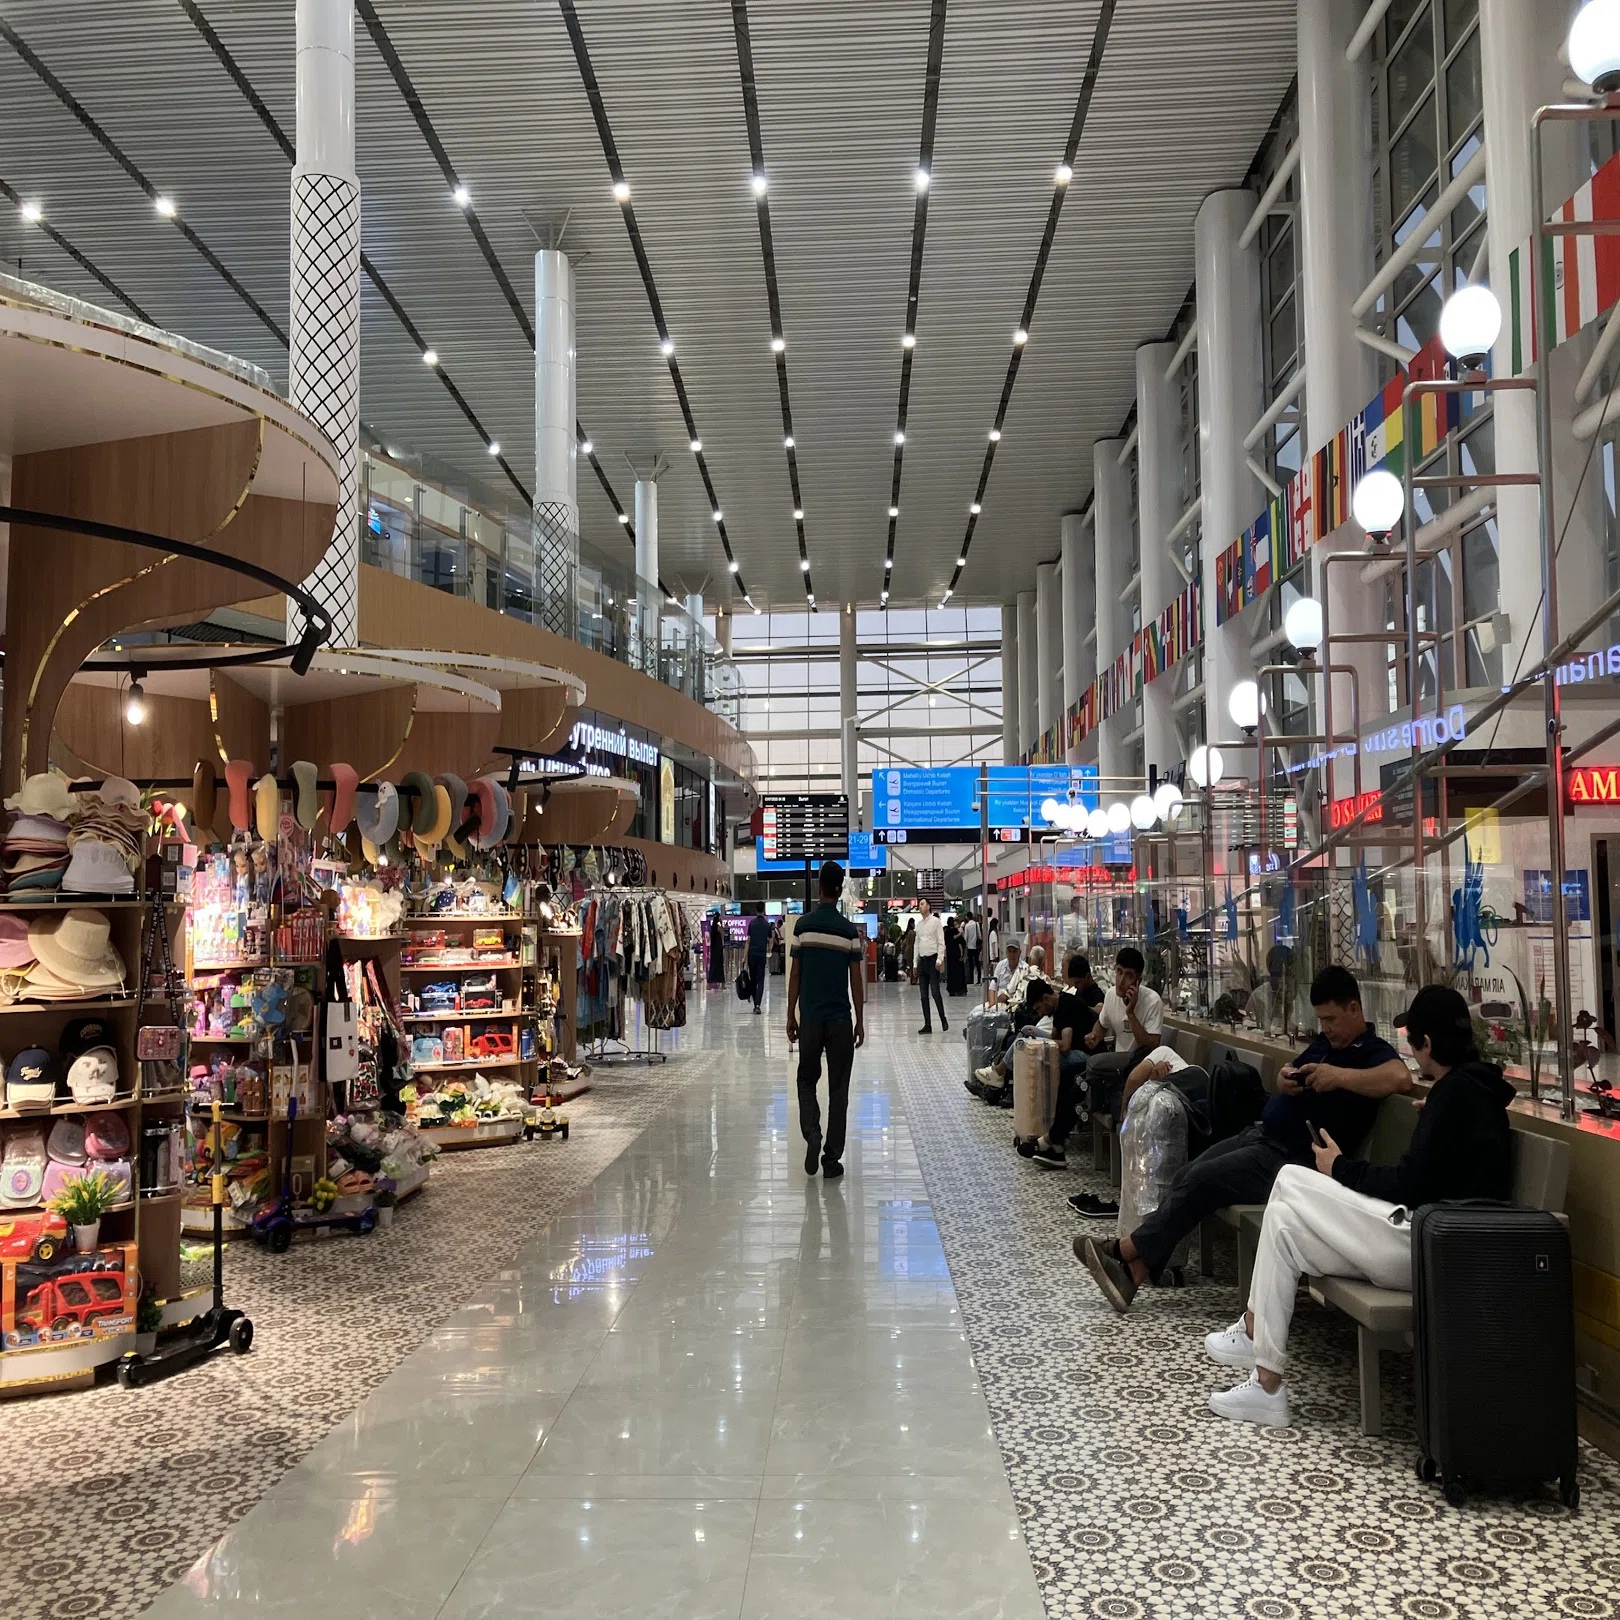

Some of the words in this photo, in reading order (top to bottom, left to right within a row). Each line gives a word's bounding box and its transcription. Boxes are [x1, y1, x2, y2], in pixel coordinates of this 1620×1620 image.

[569, 721, 627, 757] утренний
[629, 737, 659, 767] вылет
[728, 919, 747, 927] OFFICE
[97, 1316, 134, 1328] TRANSPORT
[103, 1326, 128, 1335] VEHICLE
